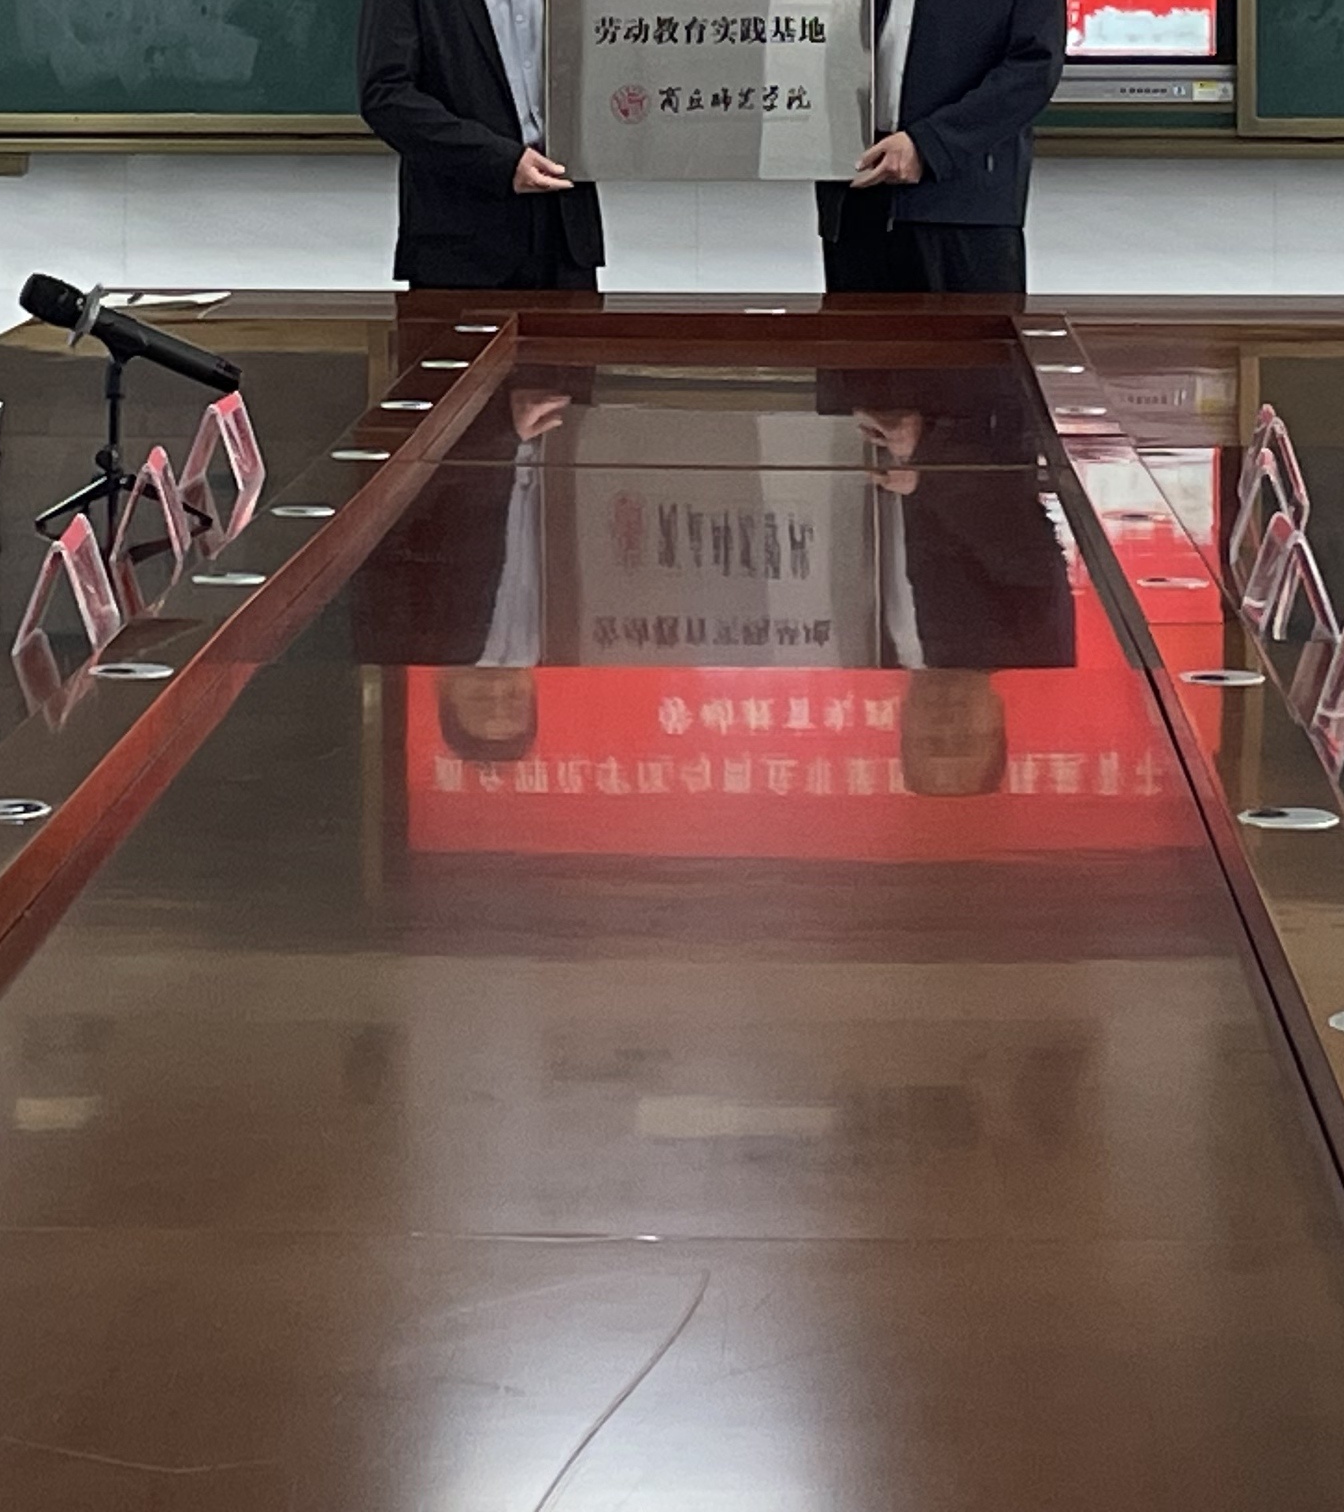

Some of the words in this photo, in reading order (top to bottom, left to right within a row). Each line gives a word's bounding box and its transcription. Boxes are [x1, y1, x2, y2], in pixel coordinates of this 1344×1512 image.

[594, 15, 828, 46] 劳动教育实践基地
[658, 85, 812, 114] 商丘师范学院
